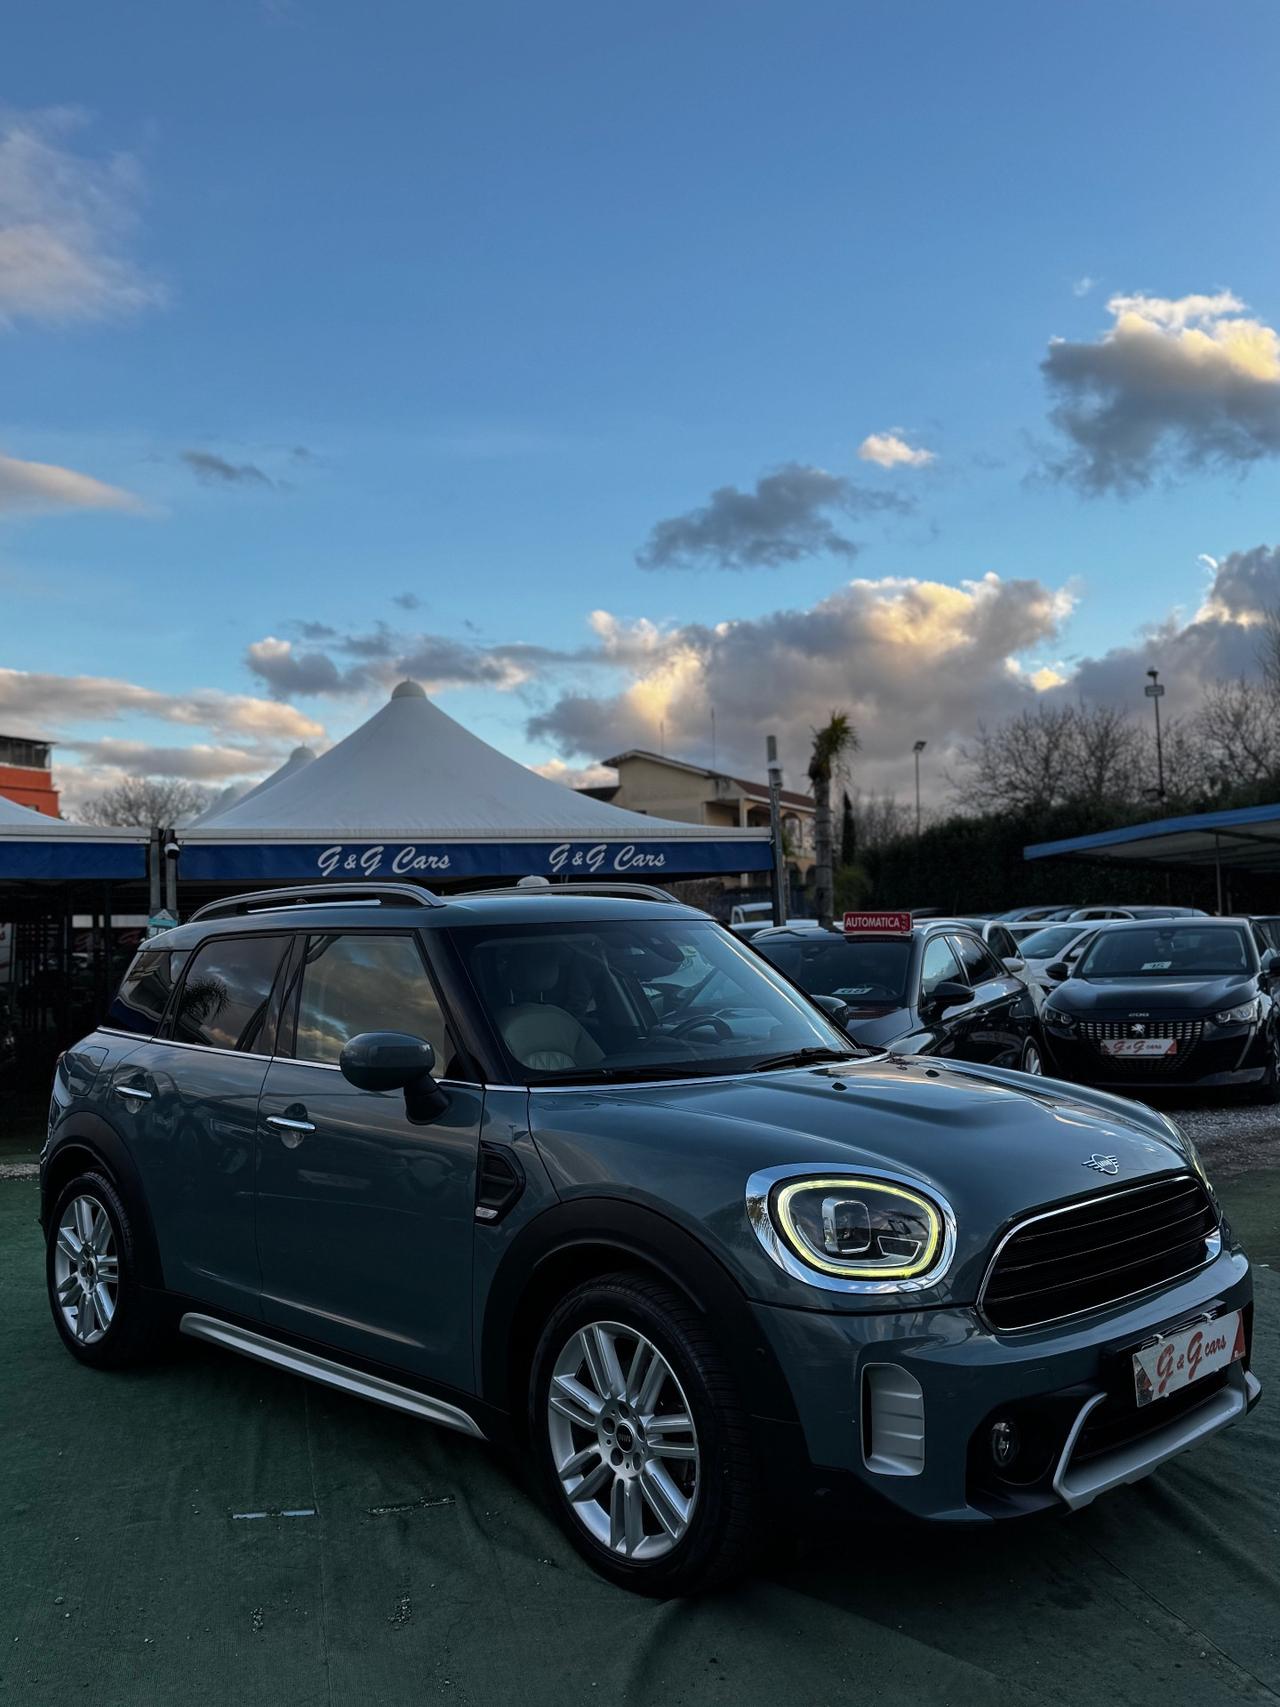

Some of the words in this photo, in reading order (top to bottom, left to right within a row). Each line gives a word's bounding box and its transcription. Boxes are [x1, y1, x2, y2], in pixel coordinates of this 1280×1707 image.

[391, 846, 451, 874] Cars
[613, 845, 667, 871] Cars
[845, 916, 900, 928] AUTOMATICA
[1204, 1334, 1227, 1357] cars
